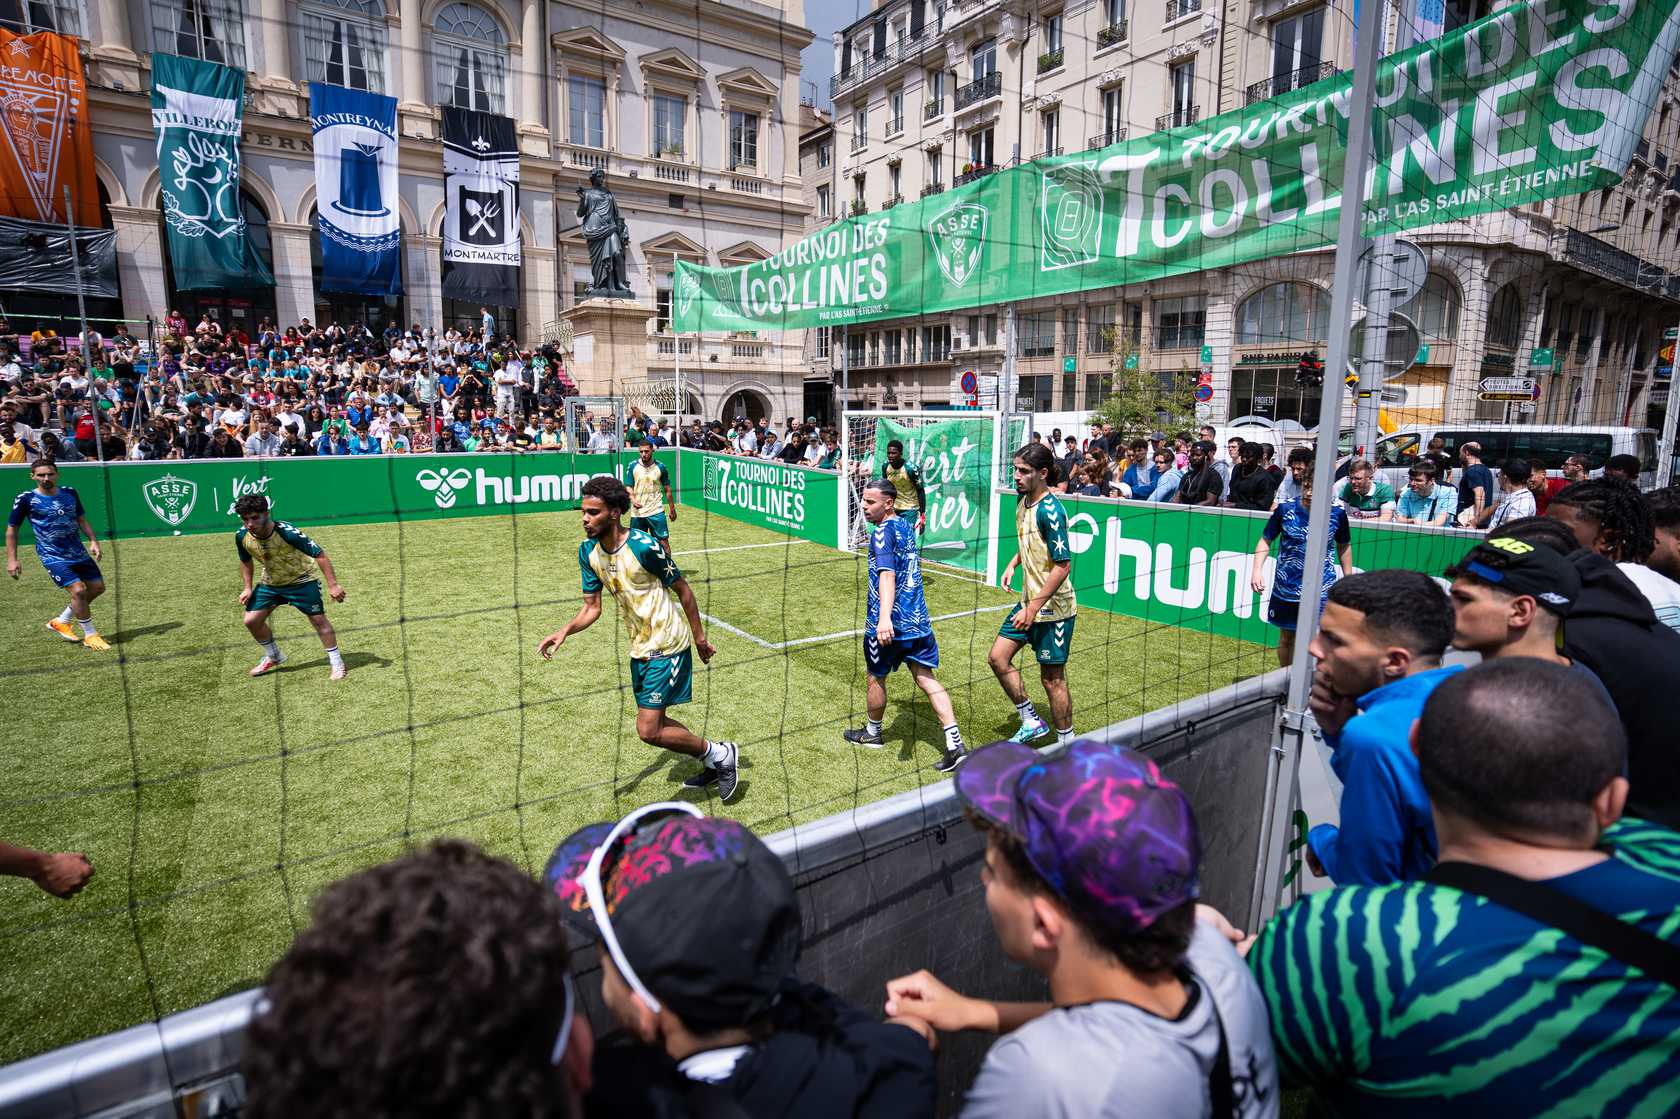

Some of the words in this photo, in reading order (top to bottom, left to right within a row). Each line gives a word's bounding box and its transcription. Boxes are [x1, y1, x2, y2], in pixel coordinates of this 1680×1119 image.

[1360, 208, 1389, 225] PAR
[1436, 159, 1593, 210] SAINT-ÉTIENNE
[852, 218, 891, 254] DES
[937, 214, 979, 240] ASSE
[445, 248, 520, 262] MONTMARTRE
[750, 253, 889, 317] COLLINES
[151, 484, 191, 496] ASSE
[232, 475, 274, 499] Vert
[718, 460, 731, 503] 7
[735, 461, 779, 486] TOURNOI
[783, 469, 806, 491] DES
[727, 479, 805, 522] COLLINES
[924, 484, 978, 533] ier
